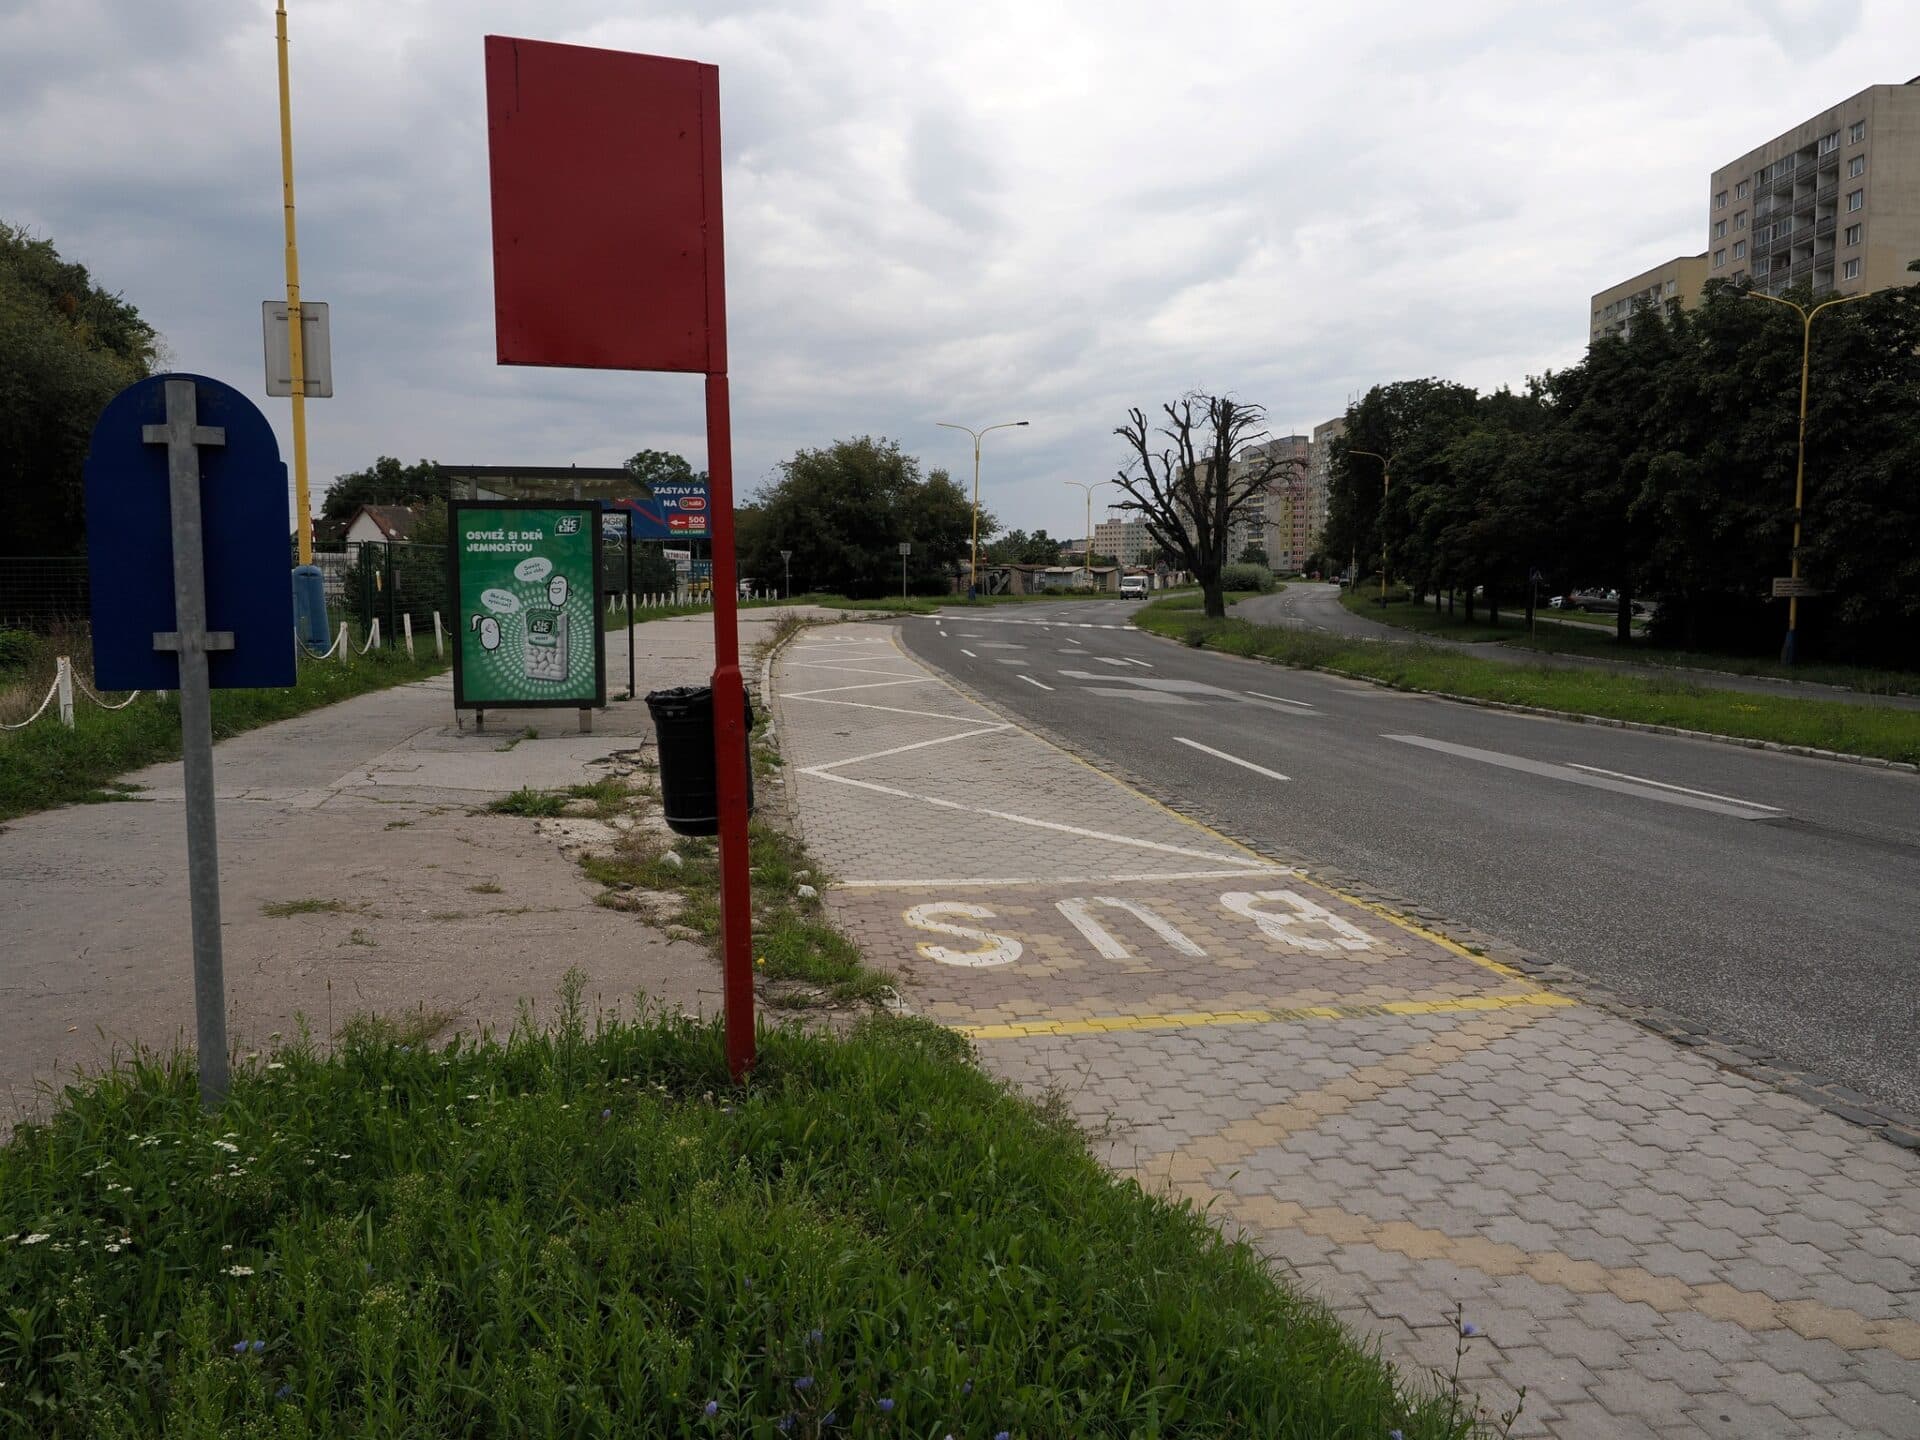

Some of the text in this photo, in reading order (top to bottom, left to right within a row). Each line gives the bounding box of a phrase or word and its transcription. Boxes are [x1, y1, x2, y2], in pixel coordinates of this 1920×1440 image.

[653, 487, 706, 495] ZASTAV SA
[562, 517, 577, 526] tic
[688, 515, 705, 523] 500
[558, 525, 577, 533] tac
[466, 528, 543, 540] OSVIEŽ SI DEŇ
[466, 540, 533, 552] JEMNOSŤOU
[533, 625, 549, 633] tac
[902, 890, 1381, 967] BUS
